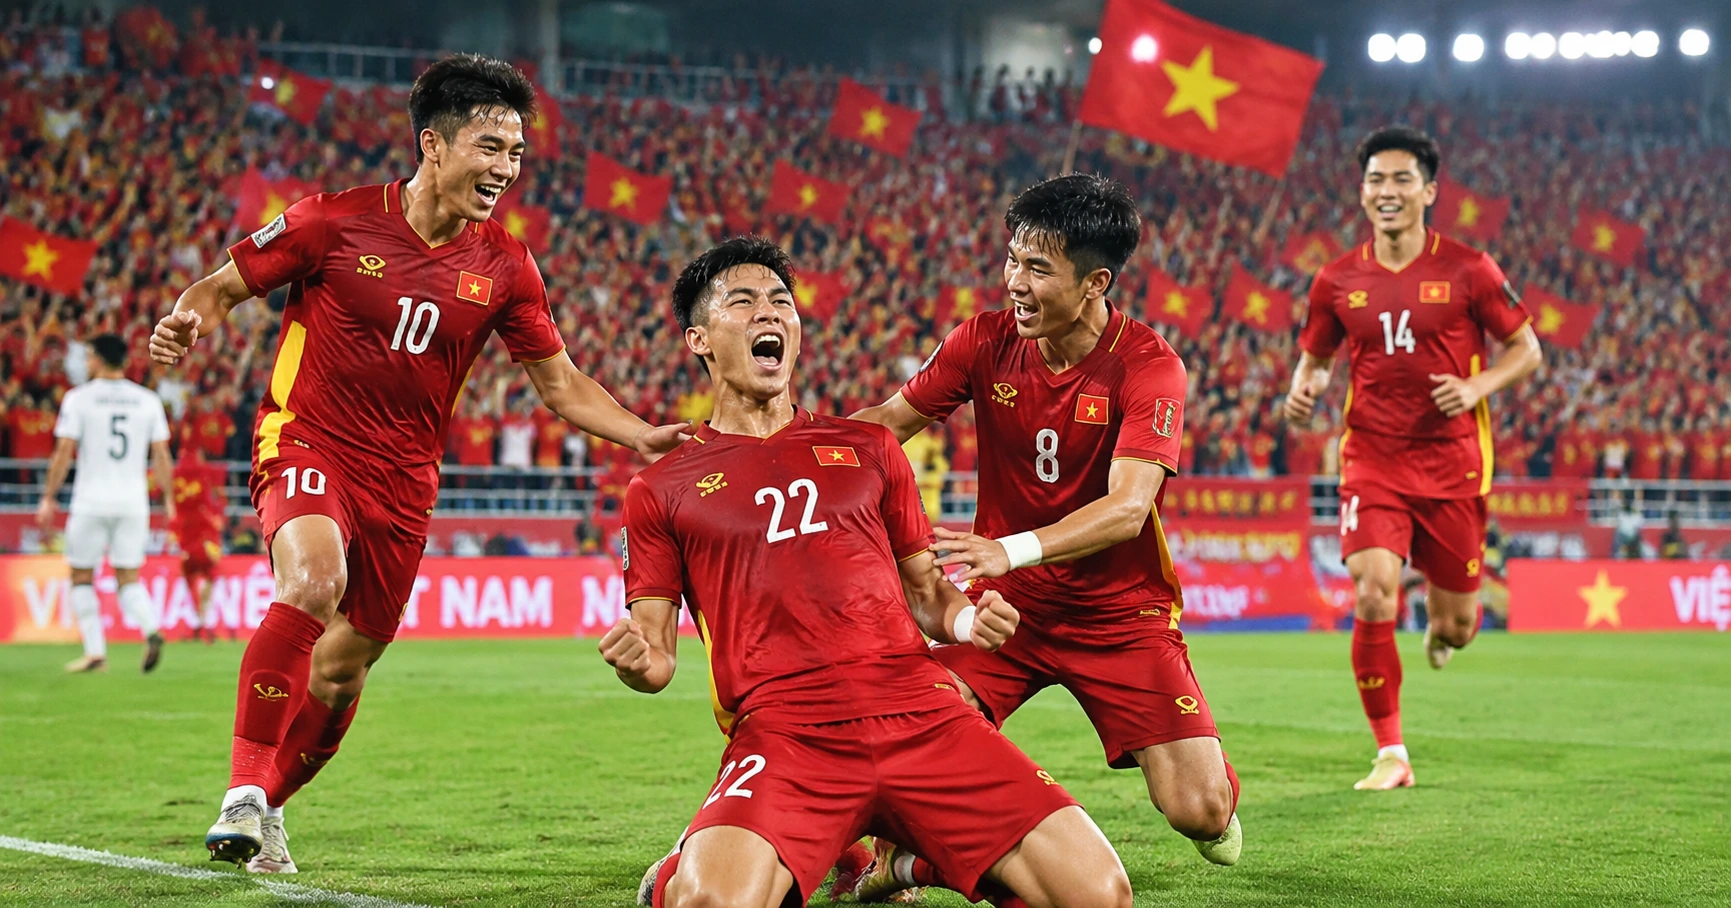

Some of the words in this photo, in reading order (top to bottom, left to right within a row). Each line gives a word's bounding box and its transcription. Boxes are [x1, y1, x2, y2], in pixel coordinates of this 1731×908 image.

[391, 296, 440, 354] 10
[1379, 309, 1416, 355] 14
[109, 415, 128, 460] 5
[1035, 428, 1060, 484] 8
[281, 467, 326, 499] 10
[754, 478, 828, 544] 22
[440, 575, 553, 629] NAM
[702, 754, 766, 810] 22
